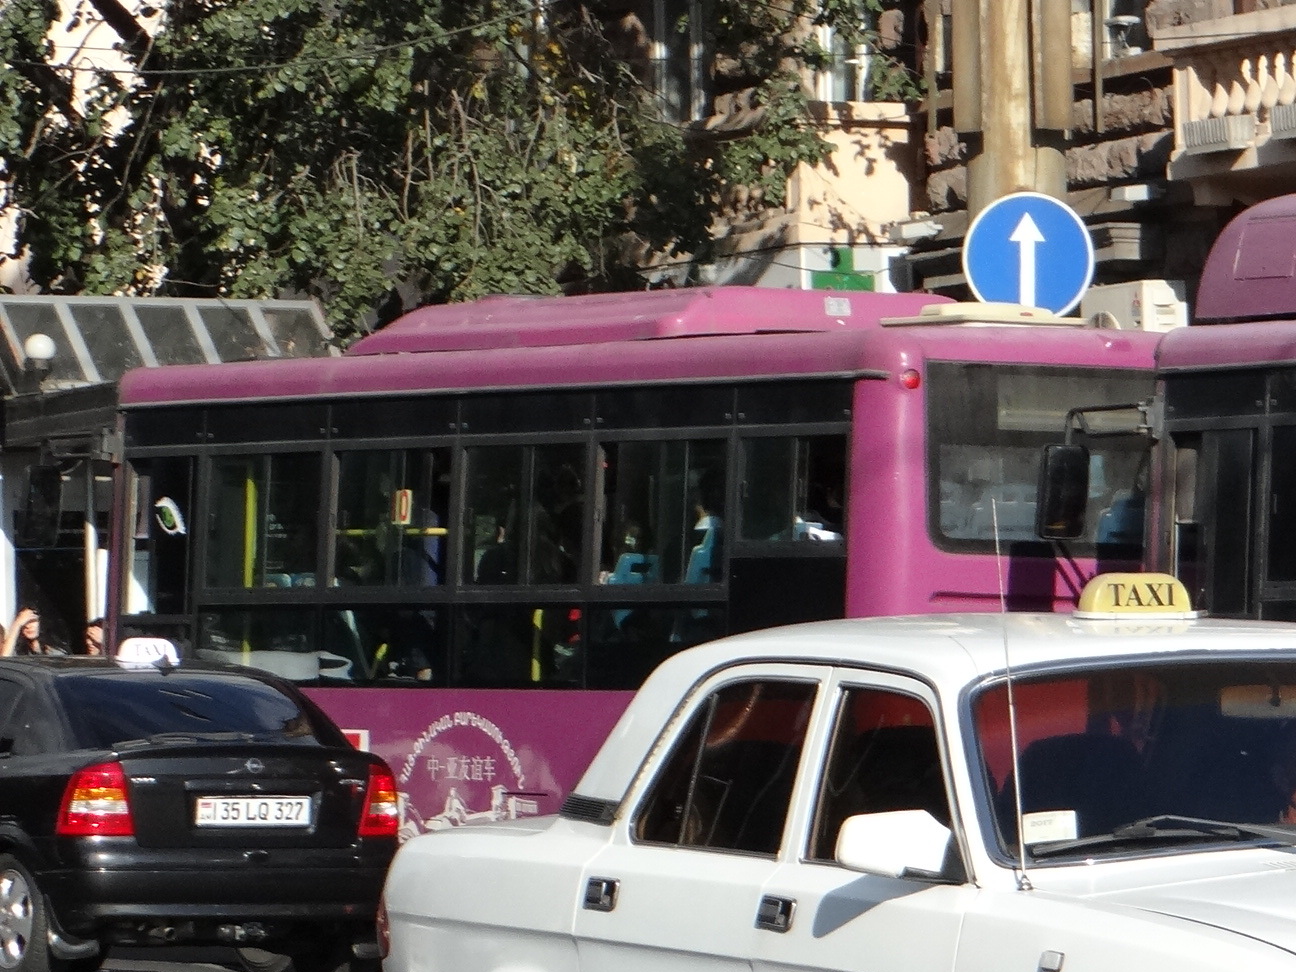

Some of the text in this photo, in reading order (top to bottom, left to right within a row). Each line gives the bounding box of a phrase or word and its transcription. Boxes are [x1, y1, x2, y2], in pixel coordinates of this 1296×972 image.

[1108, 583, 1175, 607] TAXI
[220, 802, 304, 821] 35 LQ 327
